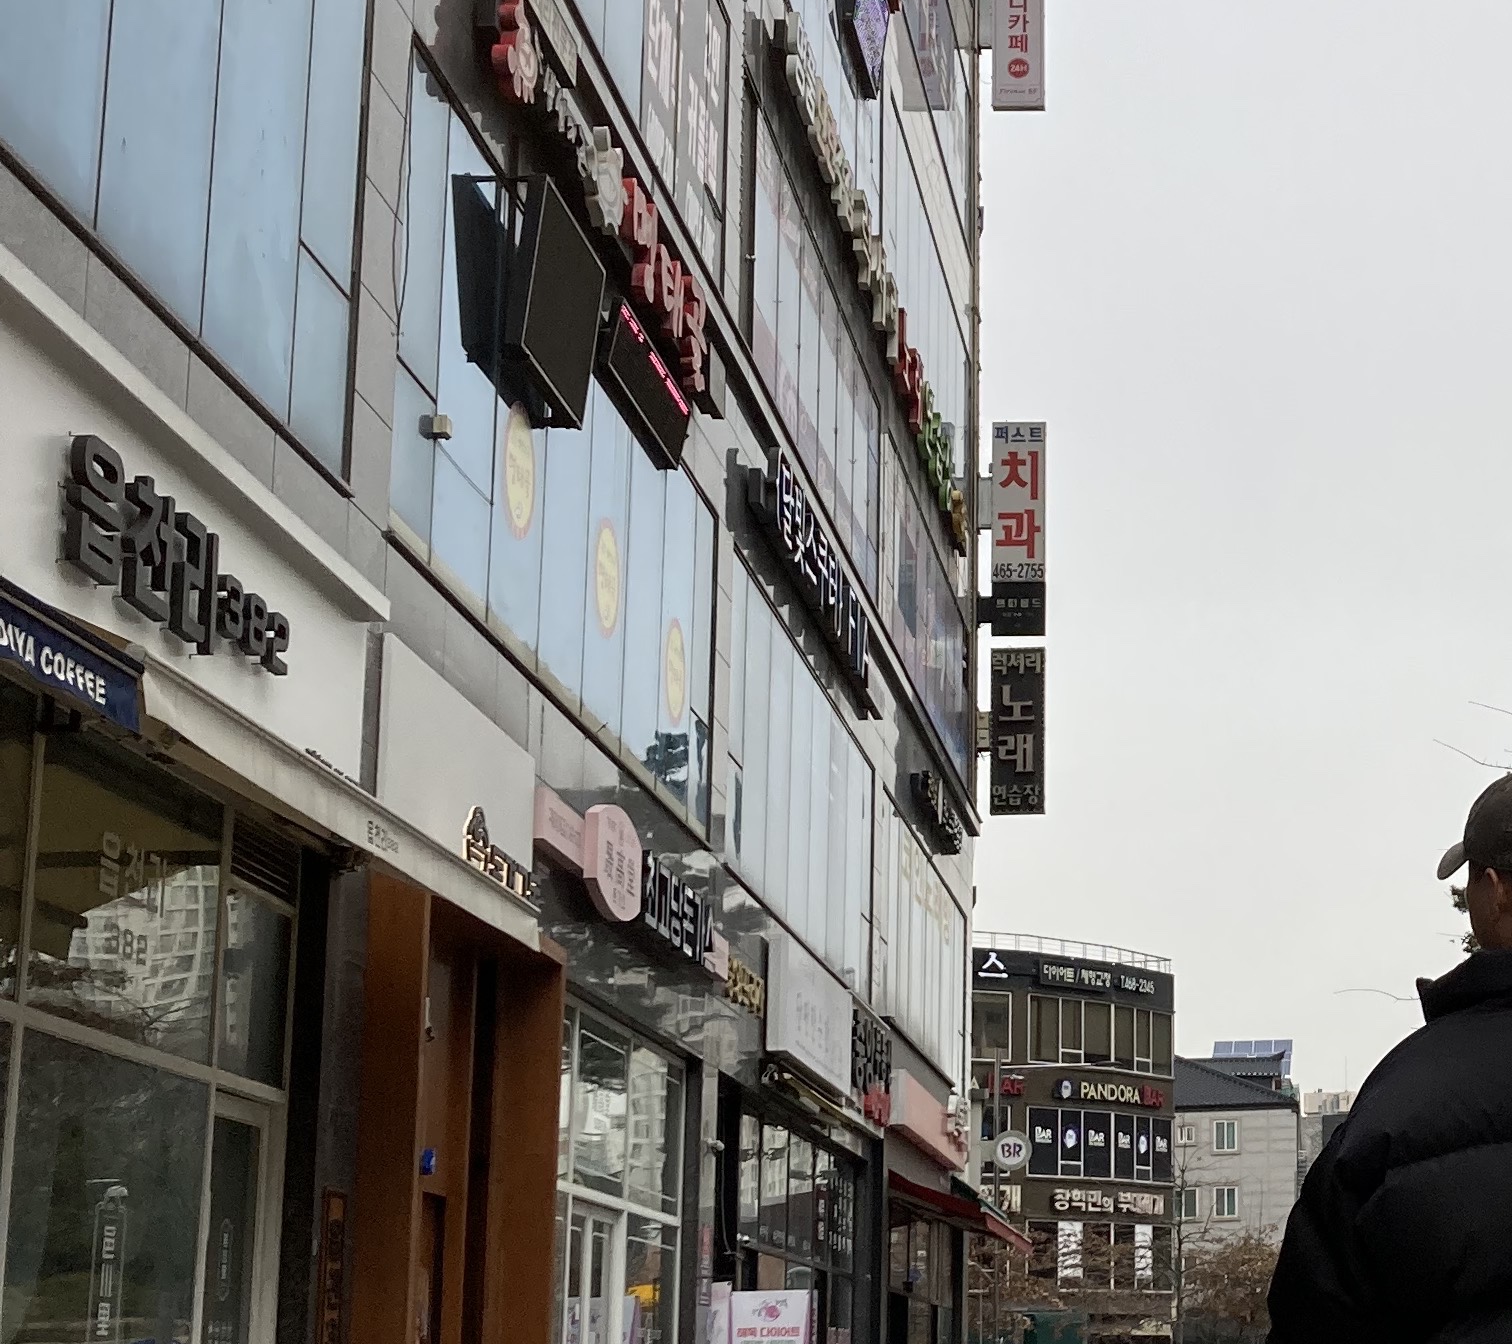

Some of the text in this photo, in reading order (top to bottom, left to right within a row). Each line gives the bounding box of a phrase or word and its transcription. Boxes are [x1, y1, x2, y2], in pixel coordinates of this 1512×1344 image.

[1009, 63, 1029, 73] 24H
[994, 425, 1044, 445] 퍼스트
[996, 450, 1042, 561] 치과
[992, 562, 1044, 581] 465-2755
[40, 645, 107, 706] COFFEE
[992, 651, 1042, 676] 럭셔리
[997, 683, 1036, 774] 노래
[992, 784, 1042, 807] 연습장
[1080, 1080, 1141, 1105] PANDORA
[1000, 1142, 1023, 1158] BR
